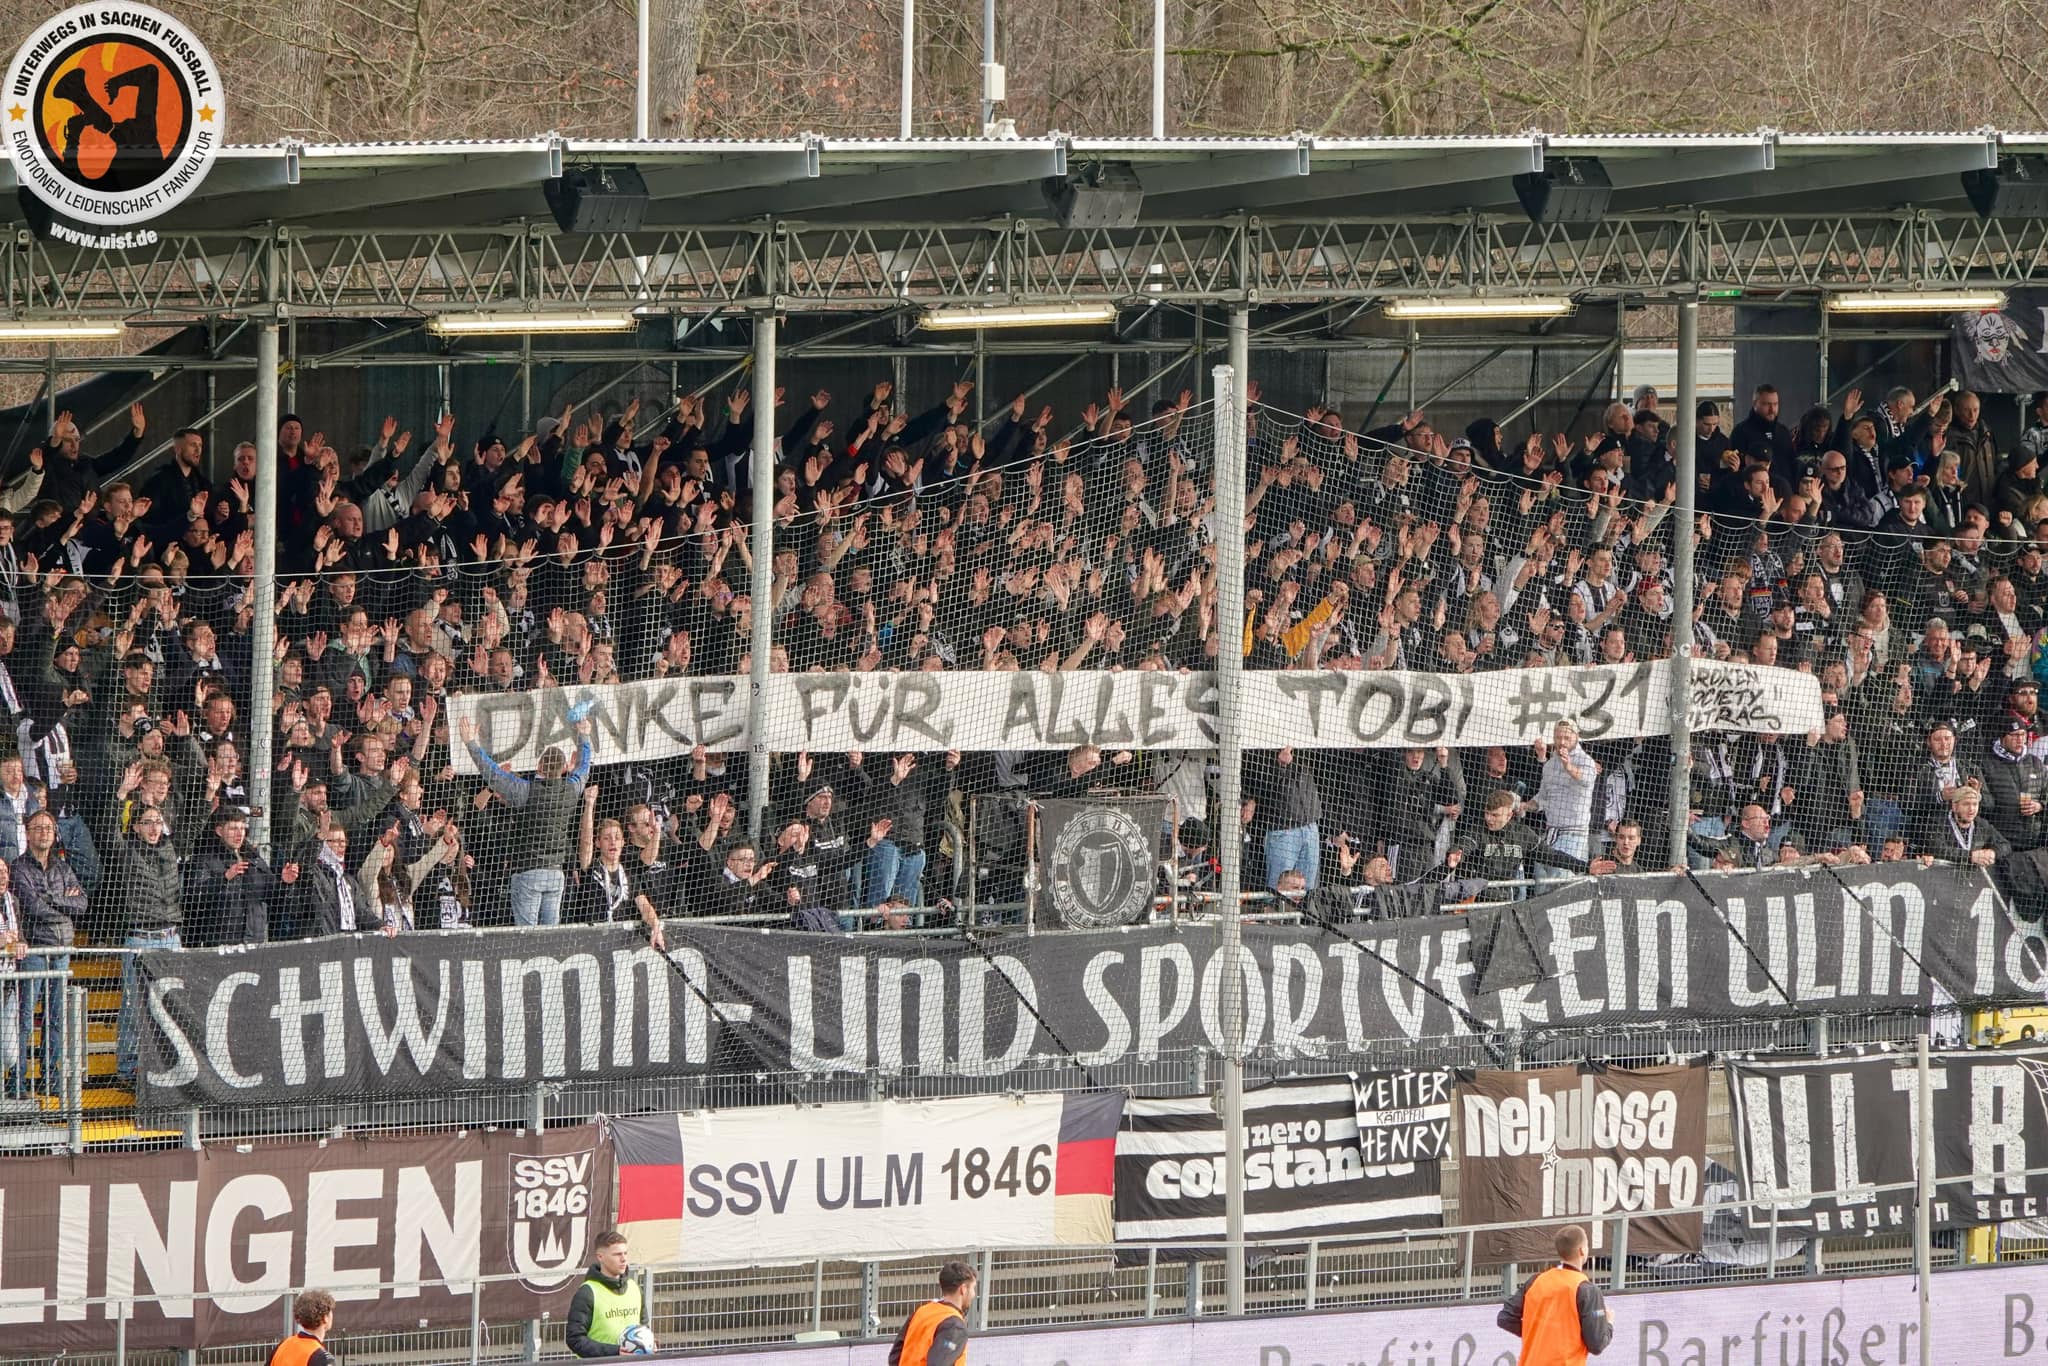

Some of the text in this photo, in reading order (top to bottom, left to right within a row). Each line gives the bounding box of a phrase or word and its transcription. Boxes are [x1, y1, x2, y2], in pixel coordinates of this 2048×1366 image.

[1690, 666, 1760, 688] ROKEN
[474, 679, 744, 762] DANKE
[795, 674, 952, 746] FÜR
[1000, 671, 1221, 747] ALLES
[1276, 671, 1474, 742] TOBI
[1507, 659, 1654, 740] #31
[1692, 688, 1764, 706] OCIETY
[1352, 1071, 1449, 1111] WEITER
[1251, 1119, 1321, 1147] nero
[1376, 1108, 1425, 1125] KÄMPFEN
[1464, 1078, 1678, 1158] nebulosa
[514, 1152, 592, 1189] SSV
[686, 1144, 1052, 1218] SSV ULM 1846
[513, 1184, 589, 1219] 1846
[1541, 1154, 1698, 1249] impero
[1815, 1202, 1950, 1232] BROKN
[1639, 1306, 1919, 1366] Barfüßer
